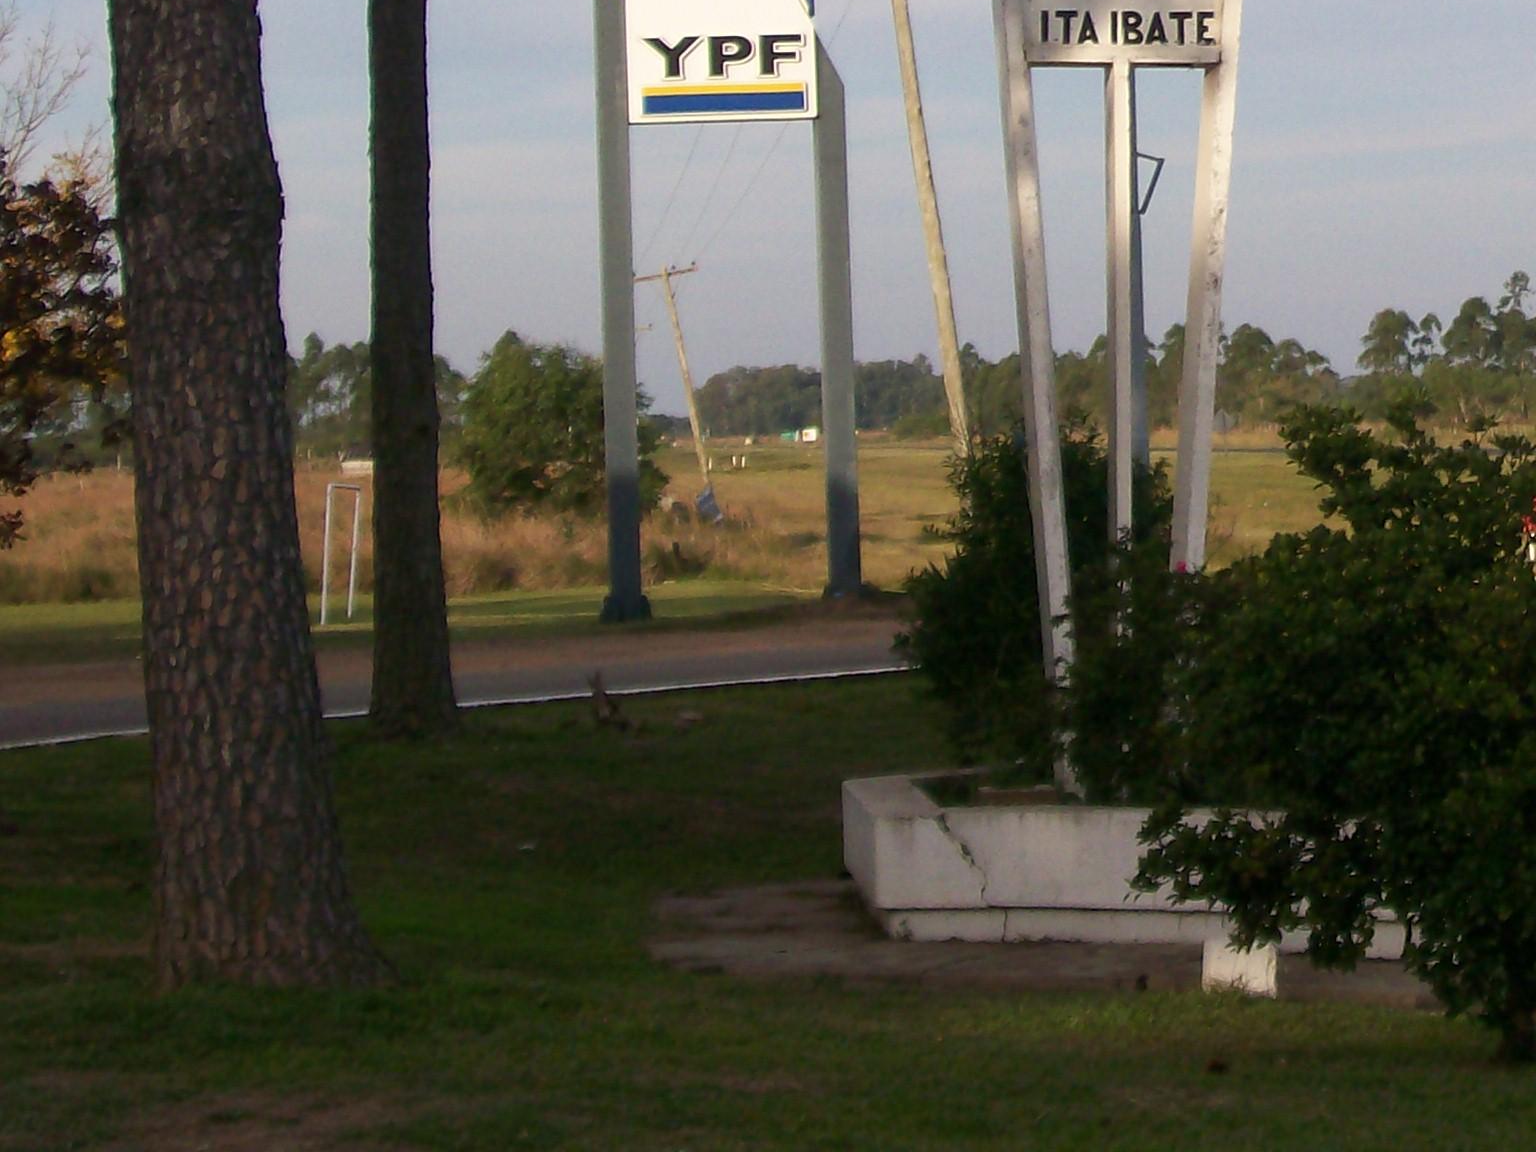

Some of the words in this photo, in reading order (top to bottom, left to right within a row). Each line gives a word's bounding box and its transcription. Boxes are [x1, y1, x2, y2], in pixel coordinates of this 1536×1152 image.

[1040, 10, 1099, 44] ITA
[1110, 11, 1217, 46] IBATE
[642, 34, 803, 78] YPF
